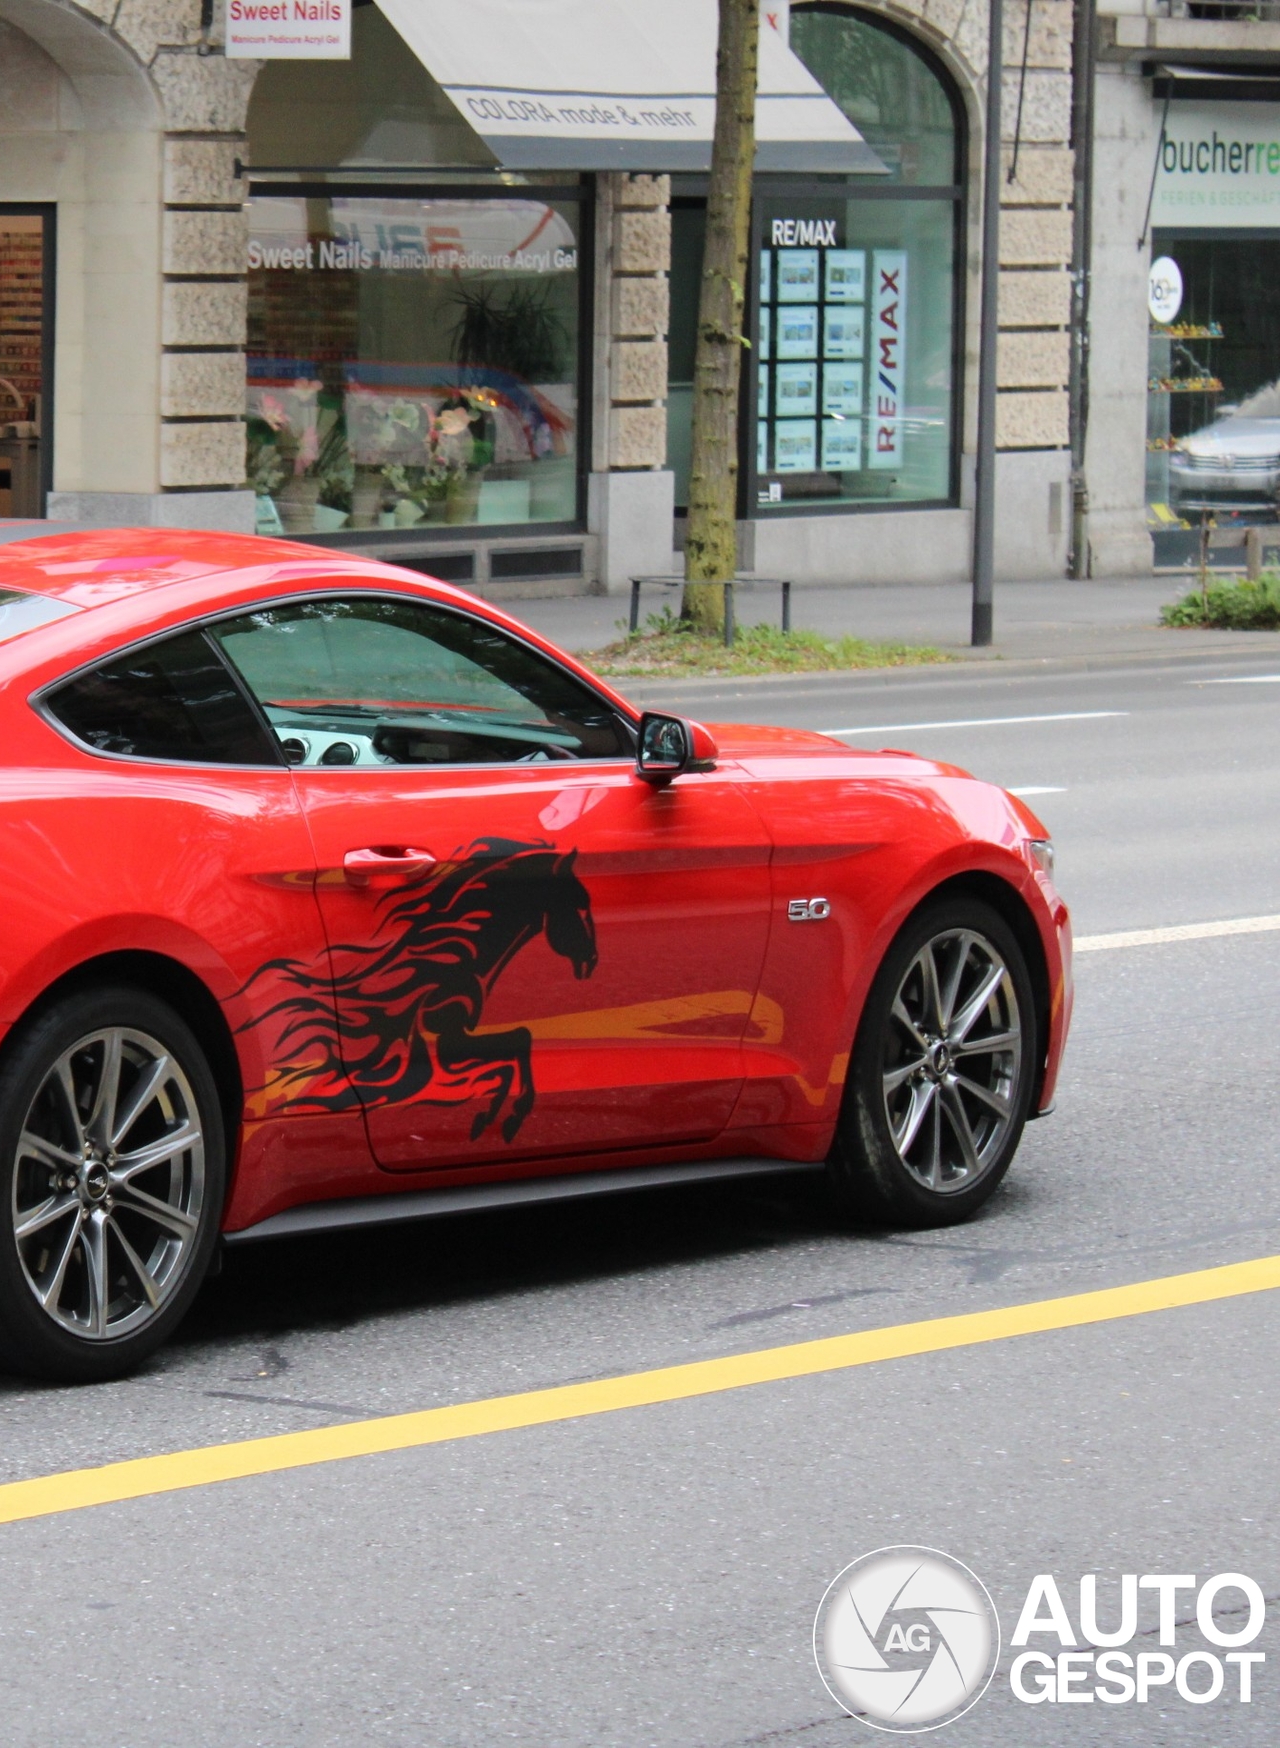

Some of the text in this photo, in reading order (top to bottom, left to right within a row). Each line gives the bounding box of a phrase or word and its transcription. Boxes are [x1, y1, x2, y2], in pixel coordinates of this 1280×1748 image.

[230, 0, 341, 20] Sweet Nails
[231, 35, 339, 45] Manicure Pedicure Acryl Gel
[466, 98, 697, 127] COLORA mode & mehr
[772, 219, 837, 247] RE/MAX
[247, 241, 578, 273] Sweet Nails Manicure Pedicure Acryl Gel
[877, 268, 899, 453] RE/MAX
